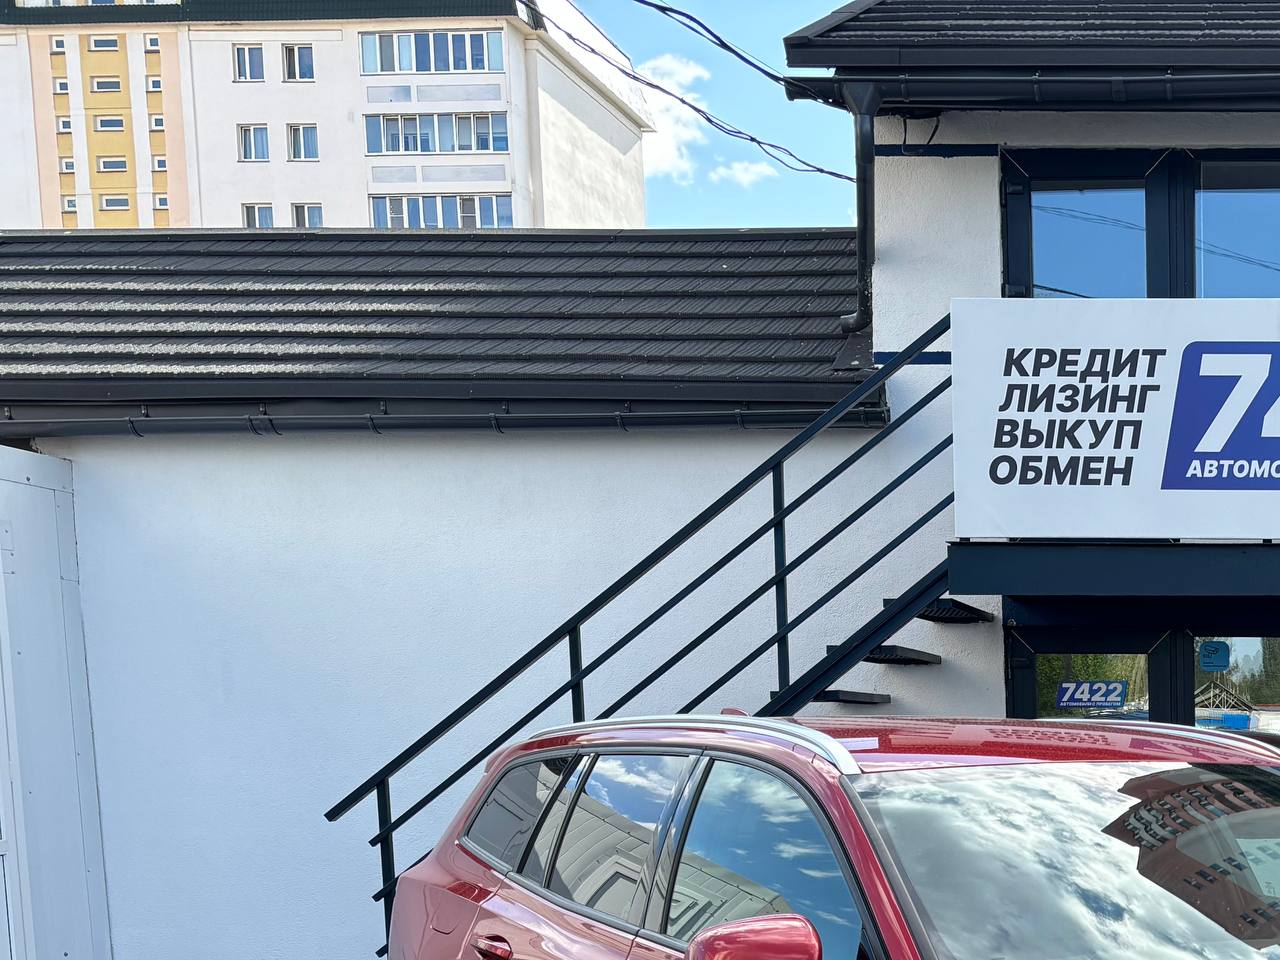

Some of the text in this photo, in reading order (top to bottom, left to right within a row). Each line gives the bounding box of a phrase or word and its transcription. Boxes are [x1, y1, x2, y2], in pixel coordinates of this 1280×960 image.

[1003, 348, 1166, 383] КРЕДИТ
[998, 384, 1160, 413] ЛИЗИНГ
[994, 420, 1142, 449] ВЫКУП
[988, 455, 1134, 486] ОБМЕН
[1062, 683, 1123, 702] 7422
